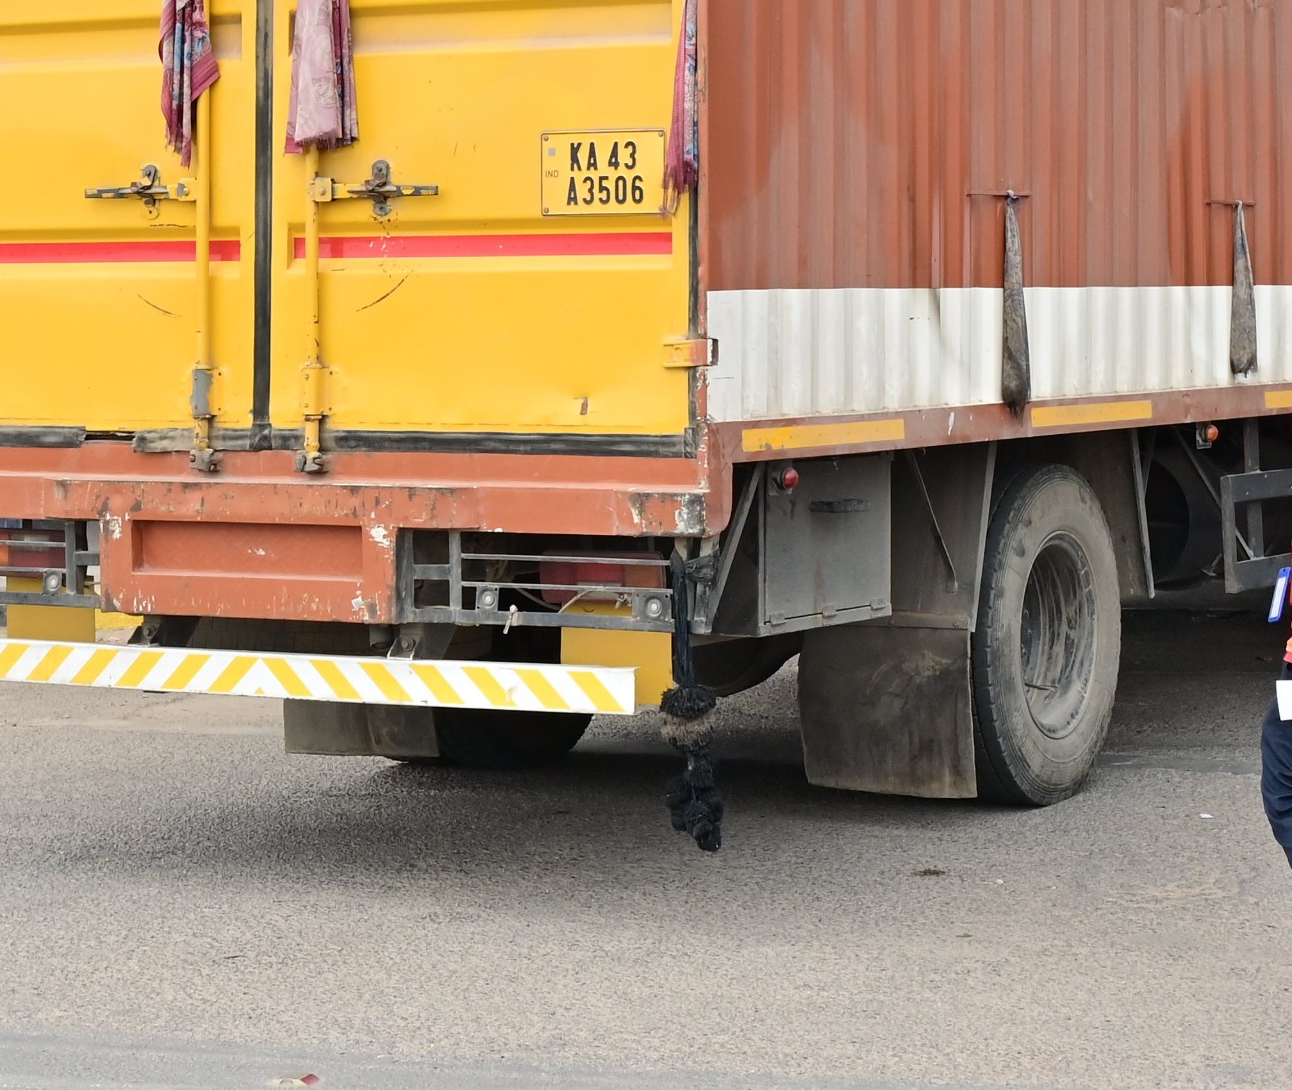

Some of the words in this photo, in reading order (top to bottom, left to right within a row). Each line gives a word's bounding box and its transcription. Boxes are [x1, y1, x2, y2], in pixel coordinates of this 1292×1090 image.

[570, 142, 598, 171] KA
[608, 141, 637, 170] 43
[545, 170, 559, 178] IND
[566, 175, 644, 205] A3506
